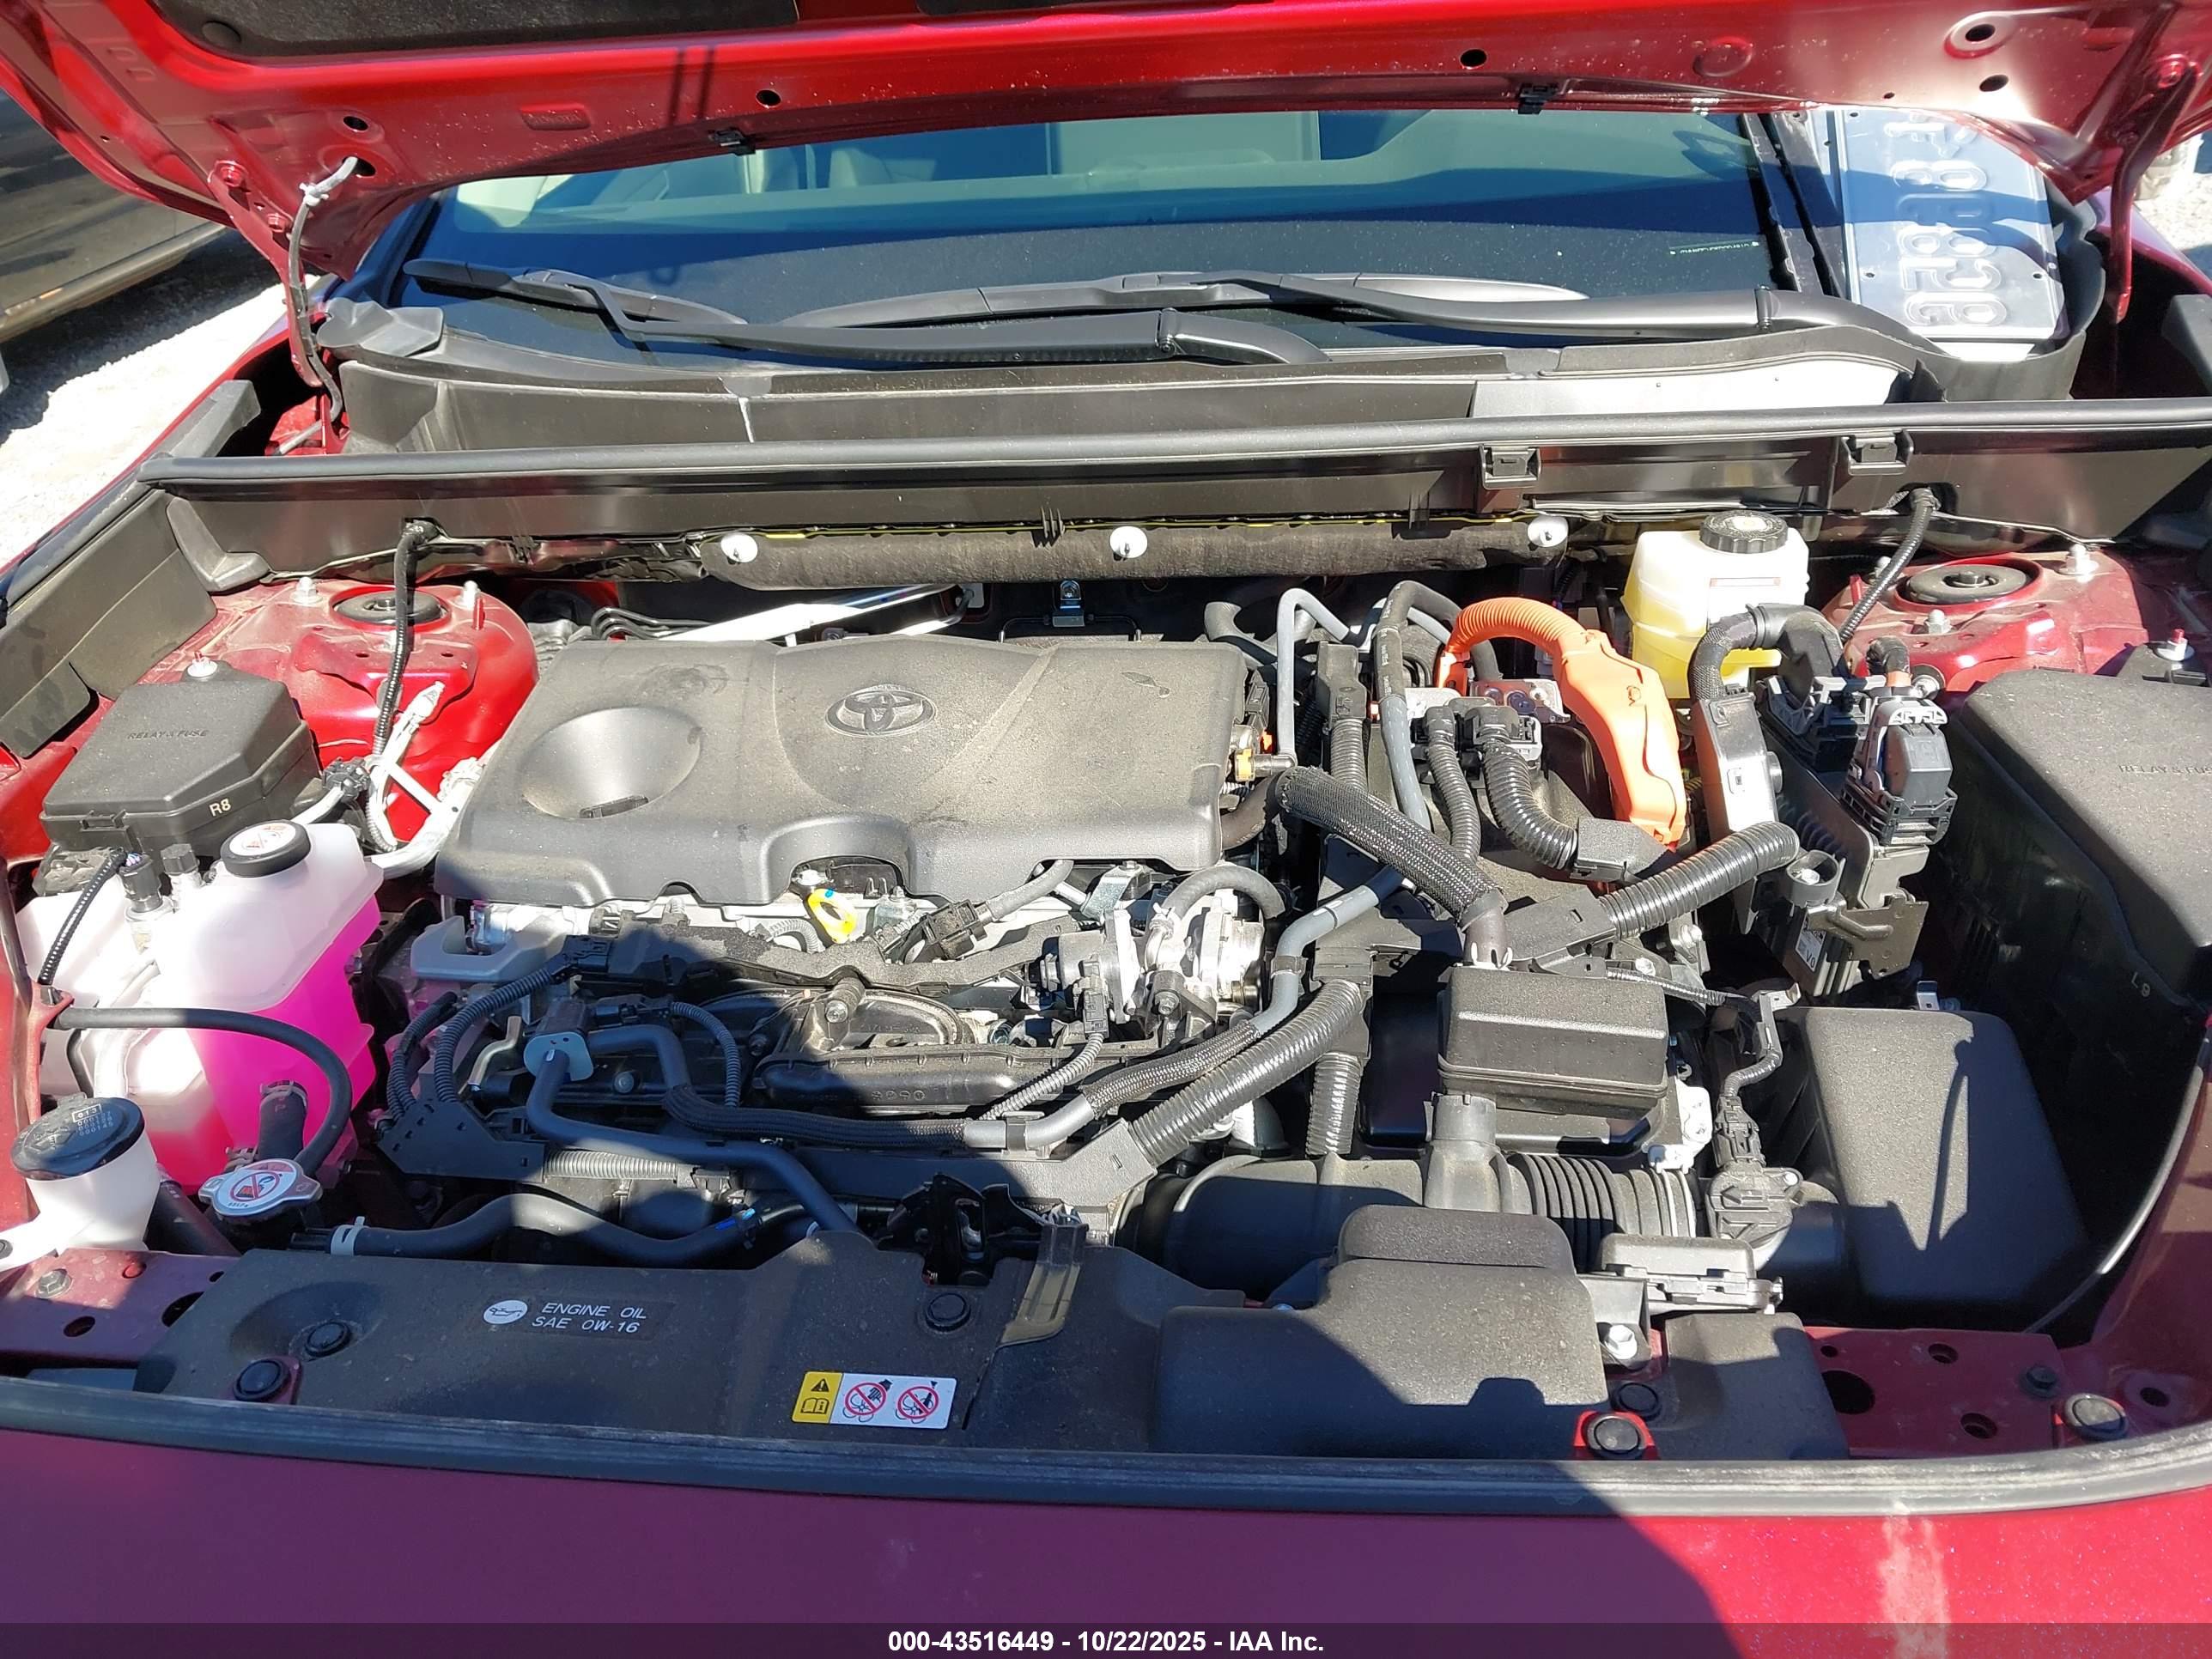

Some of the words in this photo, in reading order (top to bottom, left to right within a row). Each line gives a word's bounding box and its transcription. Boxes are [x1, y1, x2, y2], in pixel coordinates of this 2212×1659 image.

[127, 731, 167, 740] RELAY
[177, 728, 210, 738] FUSE
[2118, 764, 2167, 775] RELAY
[209, 798, 232, 817] R8
[542, 1302, 611, 1316] ENGINE
[620, 1306, 647, 1319] OIL
[532, 1316, 572, 1329] SAE
[581, 1319, 641, 1334] 0W-16
